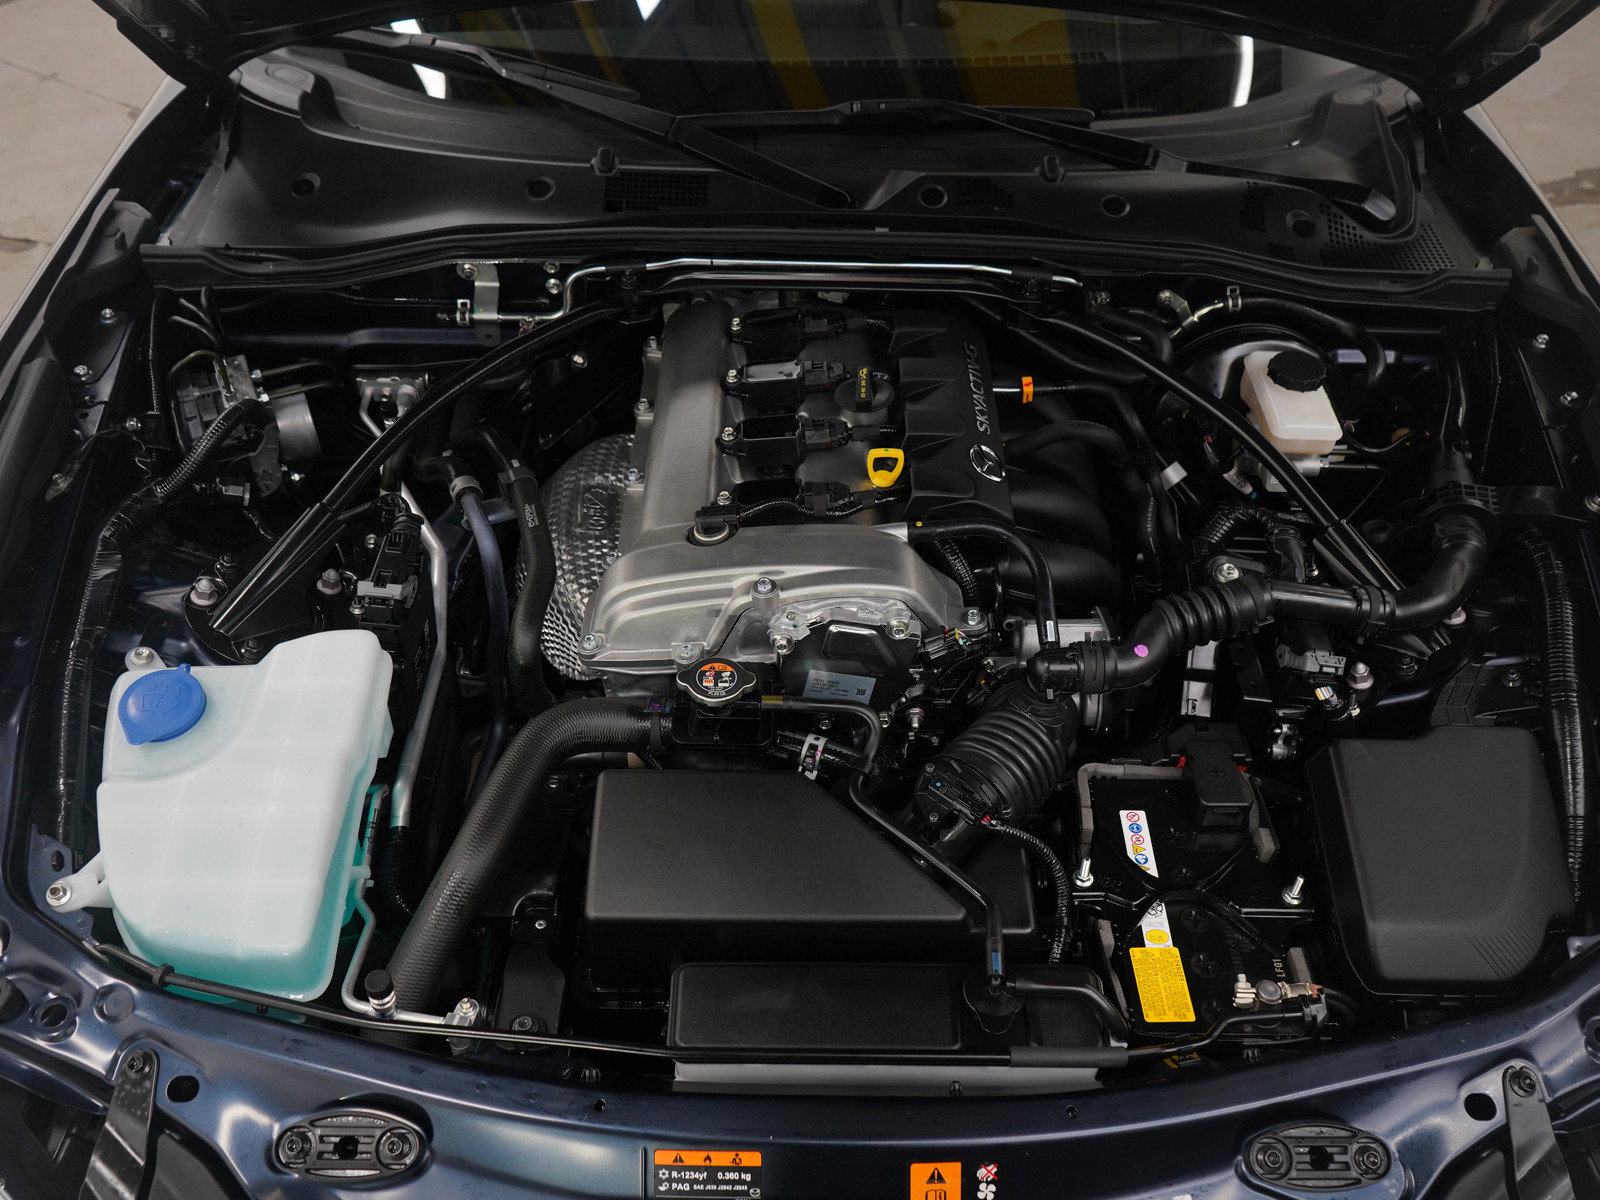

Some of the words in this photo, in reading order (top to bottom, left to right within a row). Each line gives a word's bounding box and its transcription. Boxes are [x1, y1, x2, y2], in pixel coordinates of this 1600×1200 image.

[671, 1171, 707, 1181] R-1234yf
[741, 1172, 752, 1182] kg
[671, 1183, 690, 1191] PAG
